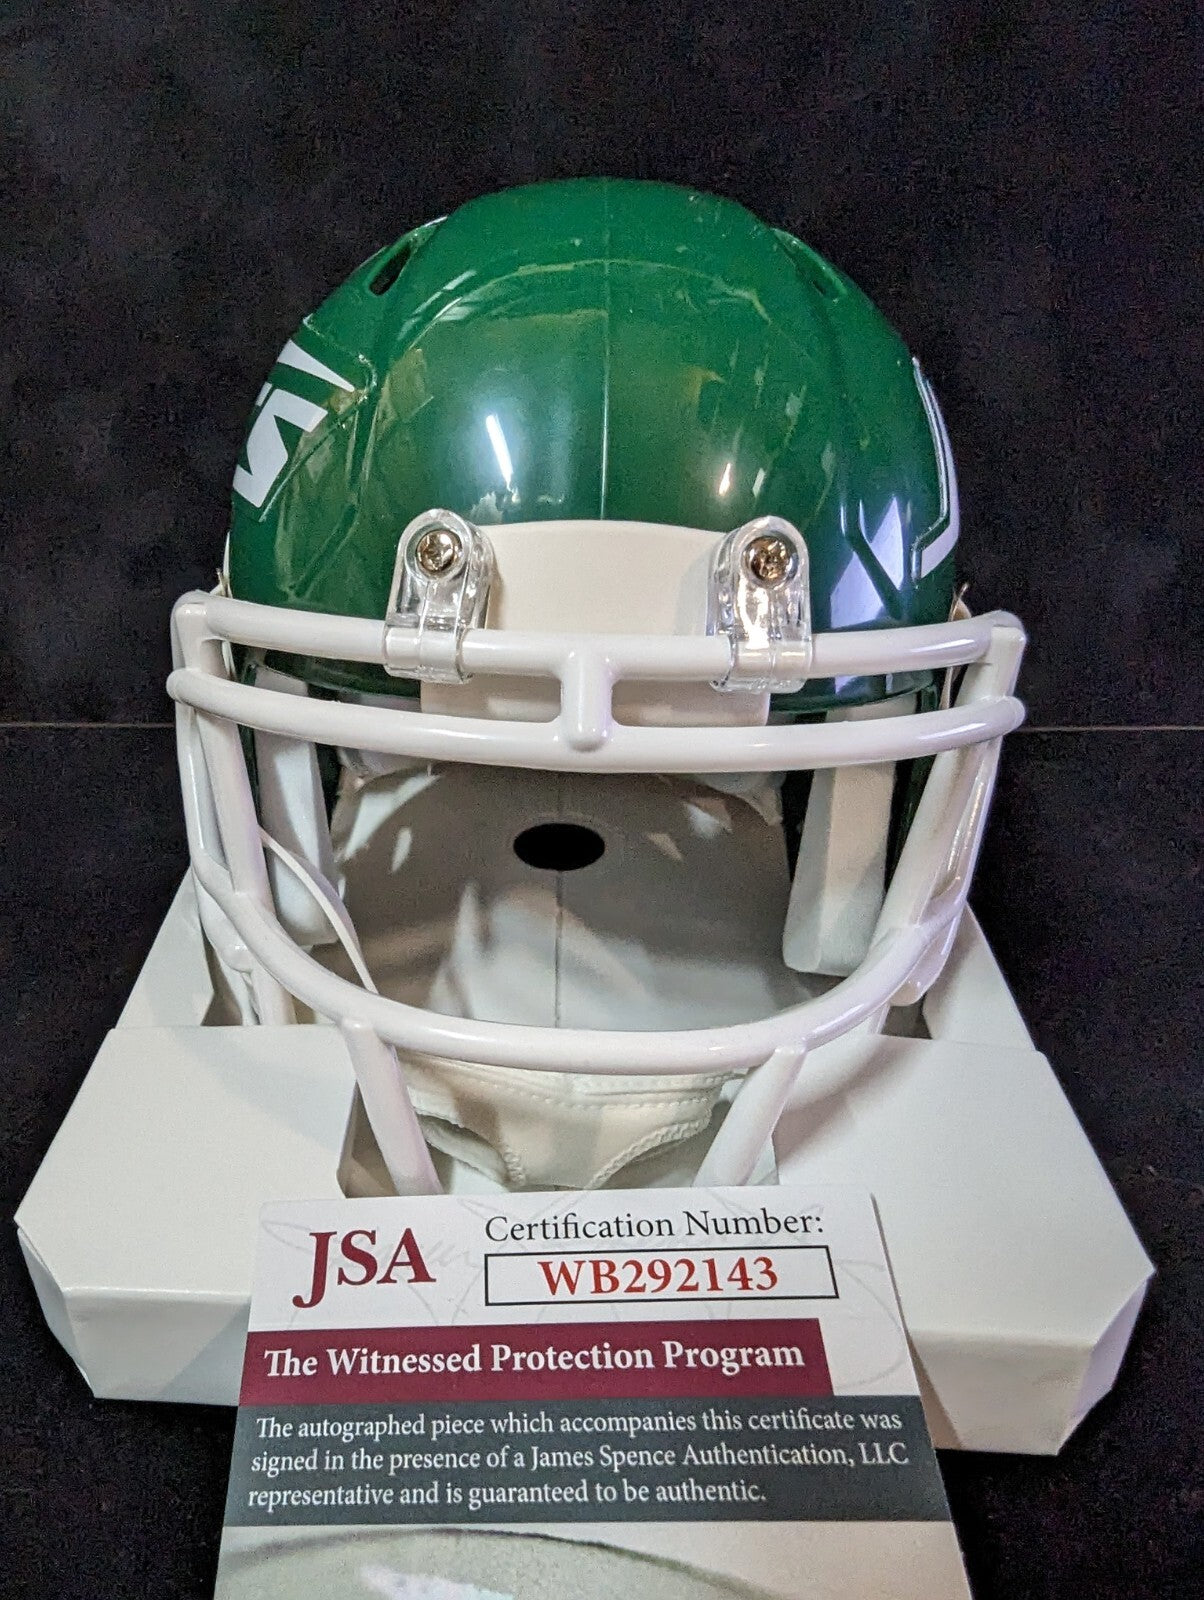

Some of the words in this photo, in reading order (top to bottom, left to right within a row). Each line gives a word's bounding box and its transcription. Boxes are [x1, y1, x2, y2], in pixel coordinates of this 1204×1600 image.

[485, 1213, 674, 1242] Certification
[683, 1208, 824, 1236] Number:
[292, 1228, 437, 1309] JSA
[537, 1256, 779, 1296] WB292143
[264, 1348, 318, 1377] The
[326, 1344, 482, 1376] Witnessed
[490, 1342, 656, 1372] Protection
[661, 1340, 806, 1377] Program
[256, 1417, 293, 1438] The
[298, 1414, 425, 1442] autographed
[430, 1413, 484, 1441] piece
[490, 1411, 553, 1434] which
[560, 1411, 697, 1438] accompanies
[702, 1409, 742, 1431] this
[748, 1408, 855, 1430] certificate
[859, 1412, 902, 1430] was
[251, 1448, 318, 1478] signed
[324, 1449, 345, 1471] in
[351, 1447, 384, 1470] the
[388, 1449, 480, 1476] presence
[486, 1445, 510, 1469] of
[513, 1452, 525, 1468] a
[530, 1446, 594, 1472] James
[599, 1445, 676, 1472] Spence
[681, 1442, 855, 1468] Authentication,
[858, 1442, 910, 1465] LLC
[248, 1483, 394, 1513] representative
[399, 1481, 439, 1504] and
[446, 1483, 463, 1504] is
[468, 1479, 589, 1511] guaranteed
[594, 1482, 618, 1502] to
[623, 1478, 650, 1502] be
[655, 1478, 767, 1502] authentic.
